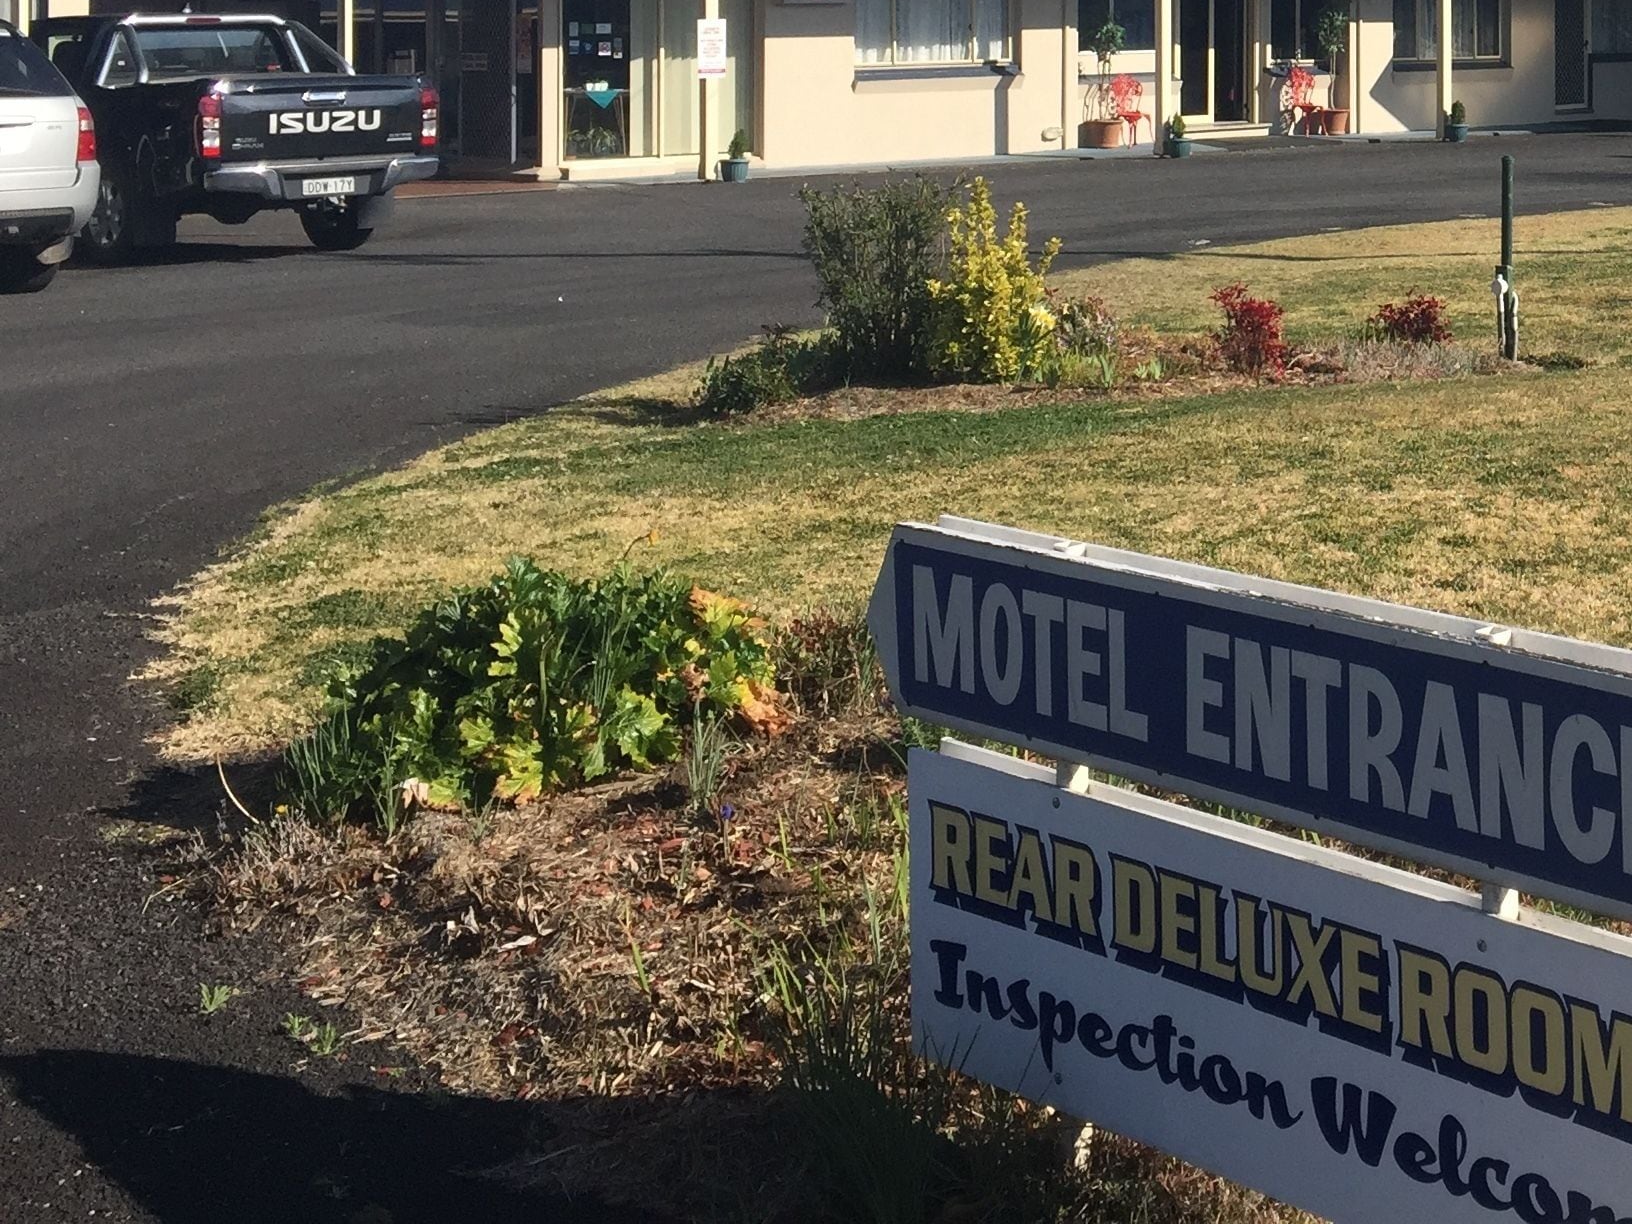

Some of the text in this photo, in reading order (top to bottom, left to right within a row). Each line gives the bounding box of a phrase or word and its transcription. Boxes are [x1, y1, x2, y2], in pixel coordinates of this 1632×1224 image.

[269, 109, 382, 135] ISUZU
[911, 564, 1149, 744] MOTEL
[928, 799, 1106, 959] REAR
[1108, 851, 1393, 1056] DELUXE
[929, 939, 1304, 1130] Inspection
